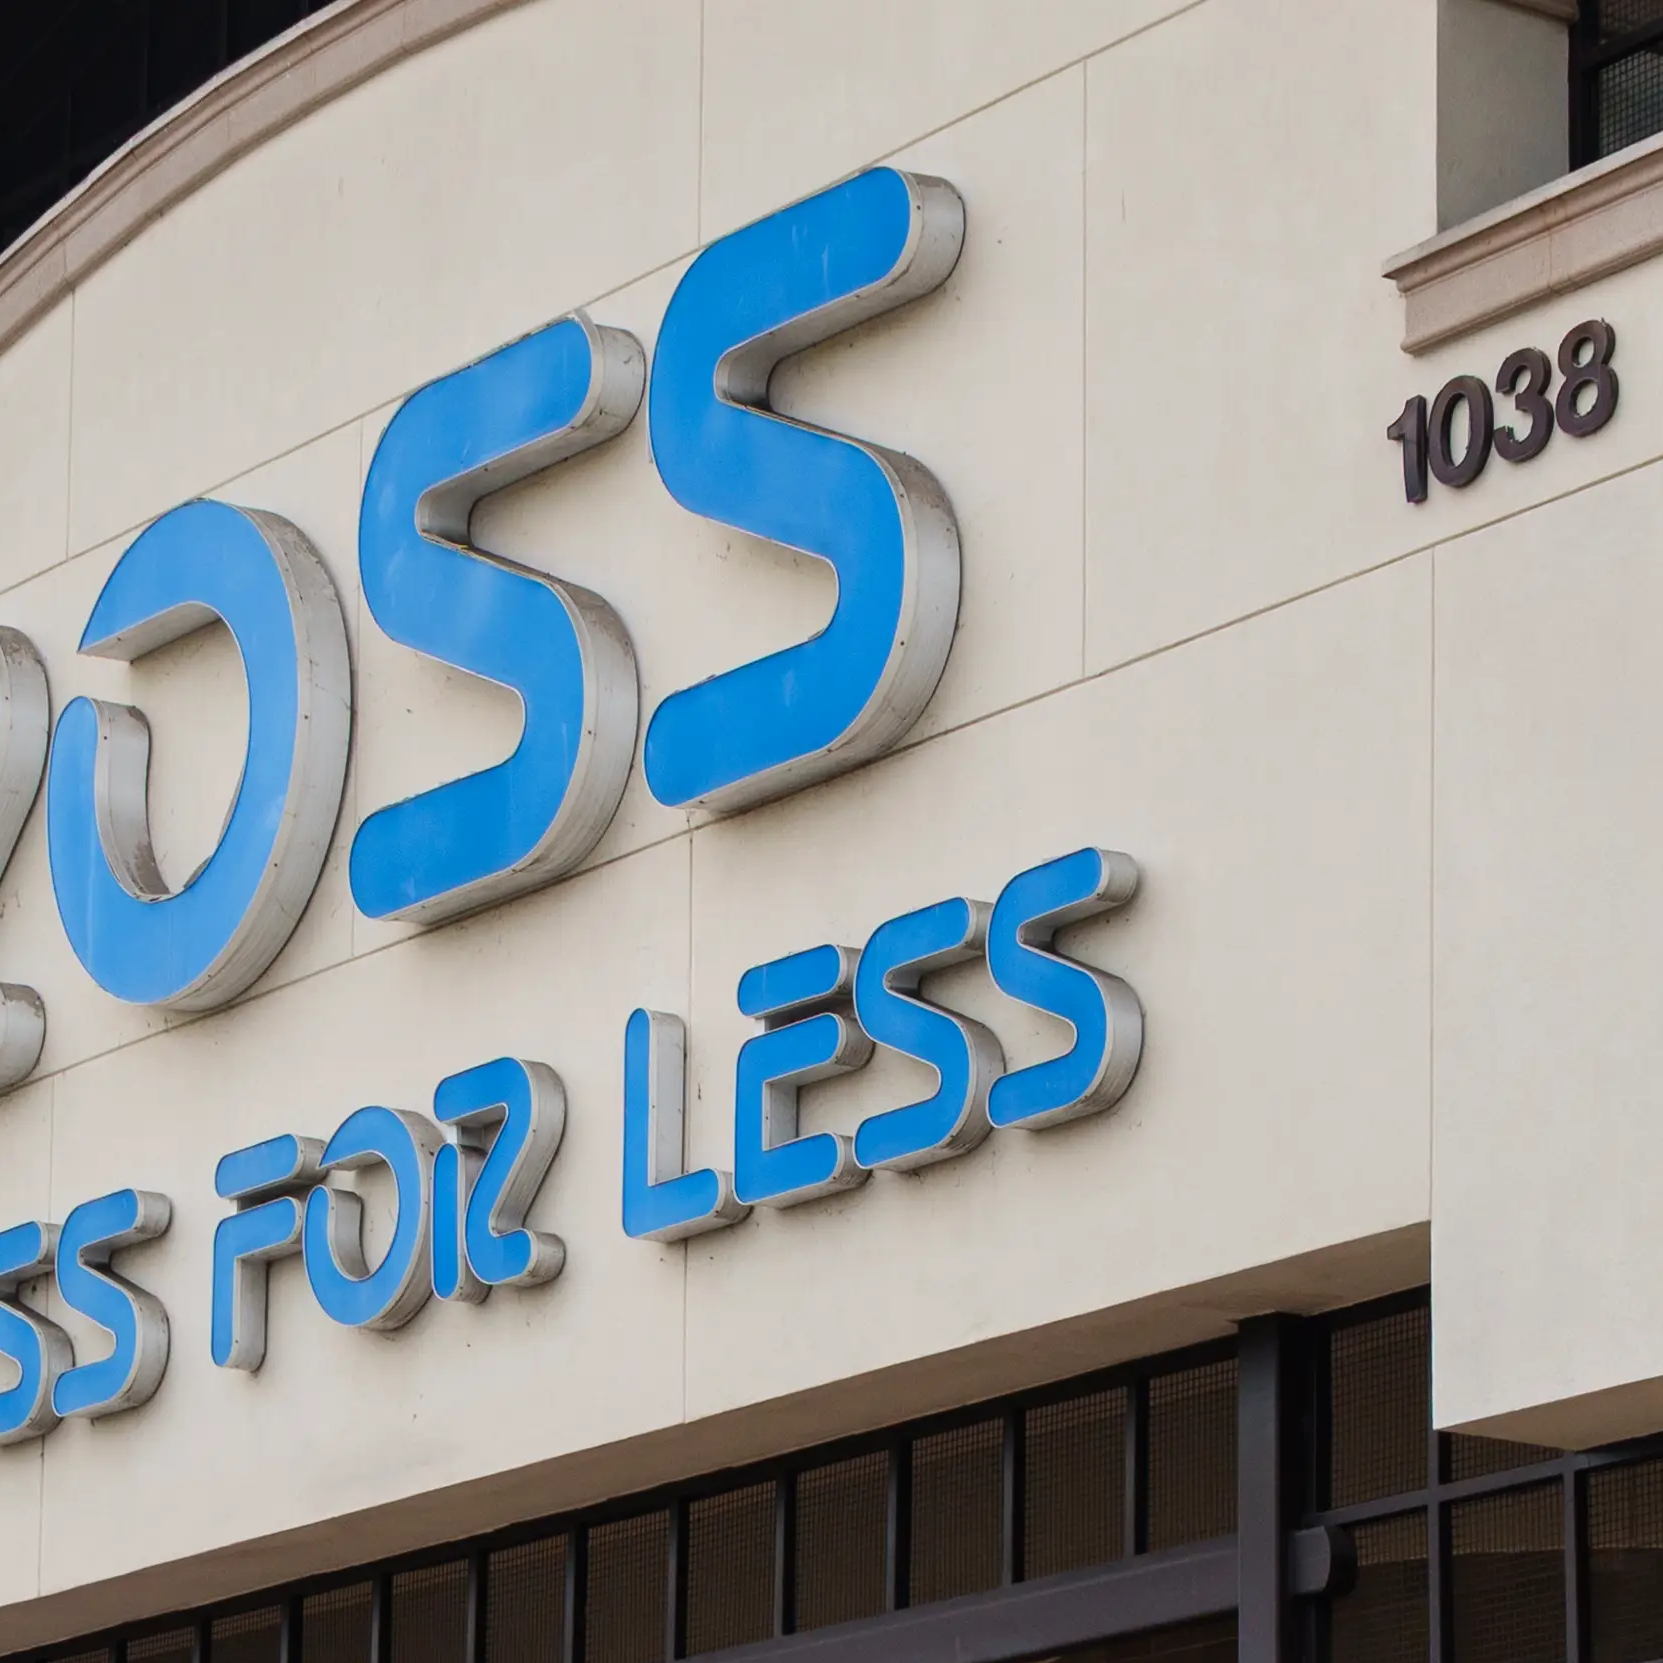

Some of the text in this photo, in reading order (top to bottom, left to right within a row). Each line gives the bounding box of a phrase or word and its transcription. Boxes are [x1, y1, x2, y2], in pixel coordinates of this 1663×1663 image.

[1387, 318, 1619, 503] 1038
[211, 1056, 568, 1372] FOR
[621, 846, 1145, 1242] LESS
